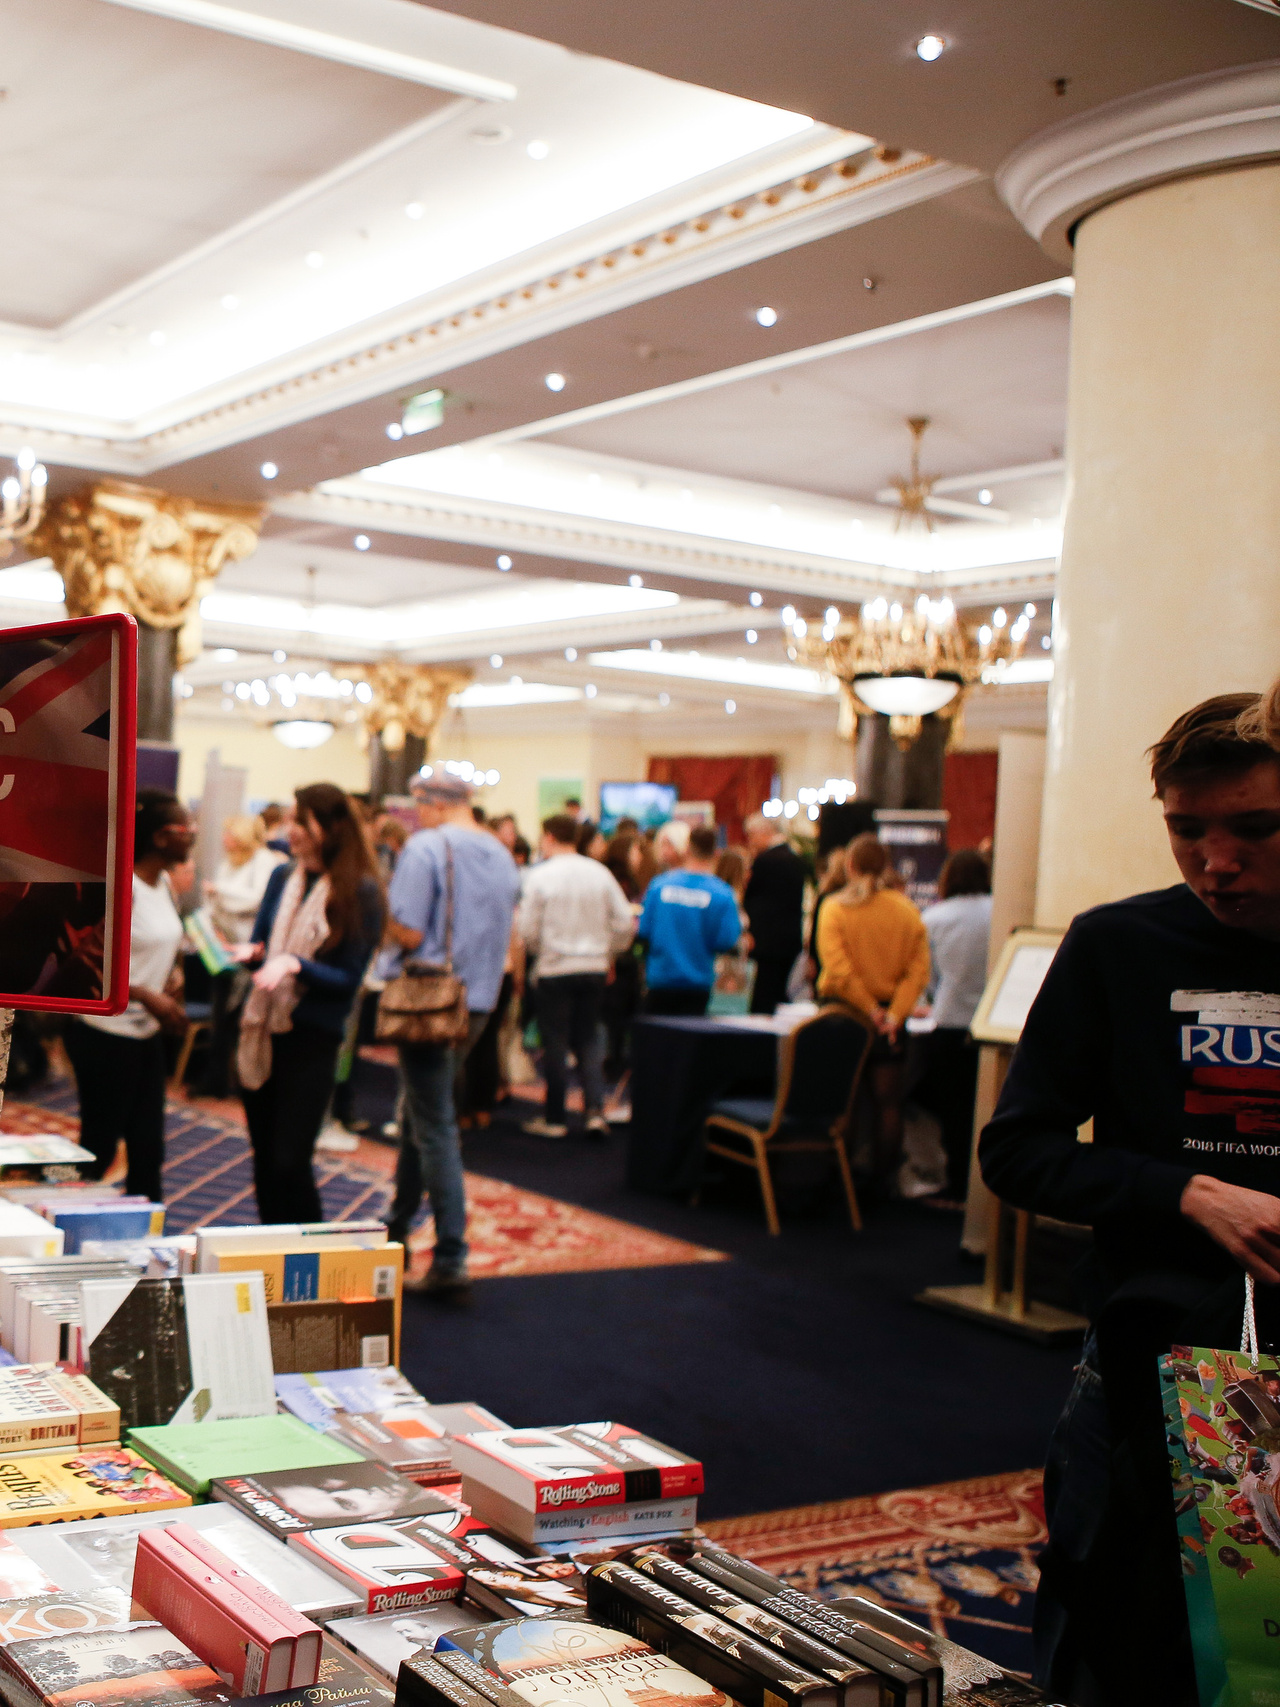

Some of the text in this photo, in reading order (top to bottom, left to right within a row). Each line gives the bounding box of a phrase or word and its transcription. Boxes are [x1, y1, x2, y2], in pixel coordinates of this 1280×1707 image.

[1183, 1138, 1214, 1152] 2018
[1217, 1141, 1247, 1155] FIFA
[30, 1423, 77, 1441] BRITAIN
[539, 1516, 585, 1530] Watching
[591, 1512, 630, 1526] English
[762, 1597, 840, 1644] КРАТКАЯ ИСТОРИЯ
[818, 1612, 857, 1635] КРАТКАЯ
[526, 1657, 669, 1692] ЛОНДОН
[304, 1687, 372, 1704] Райли
